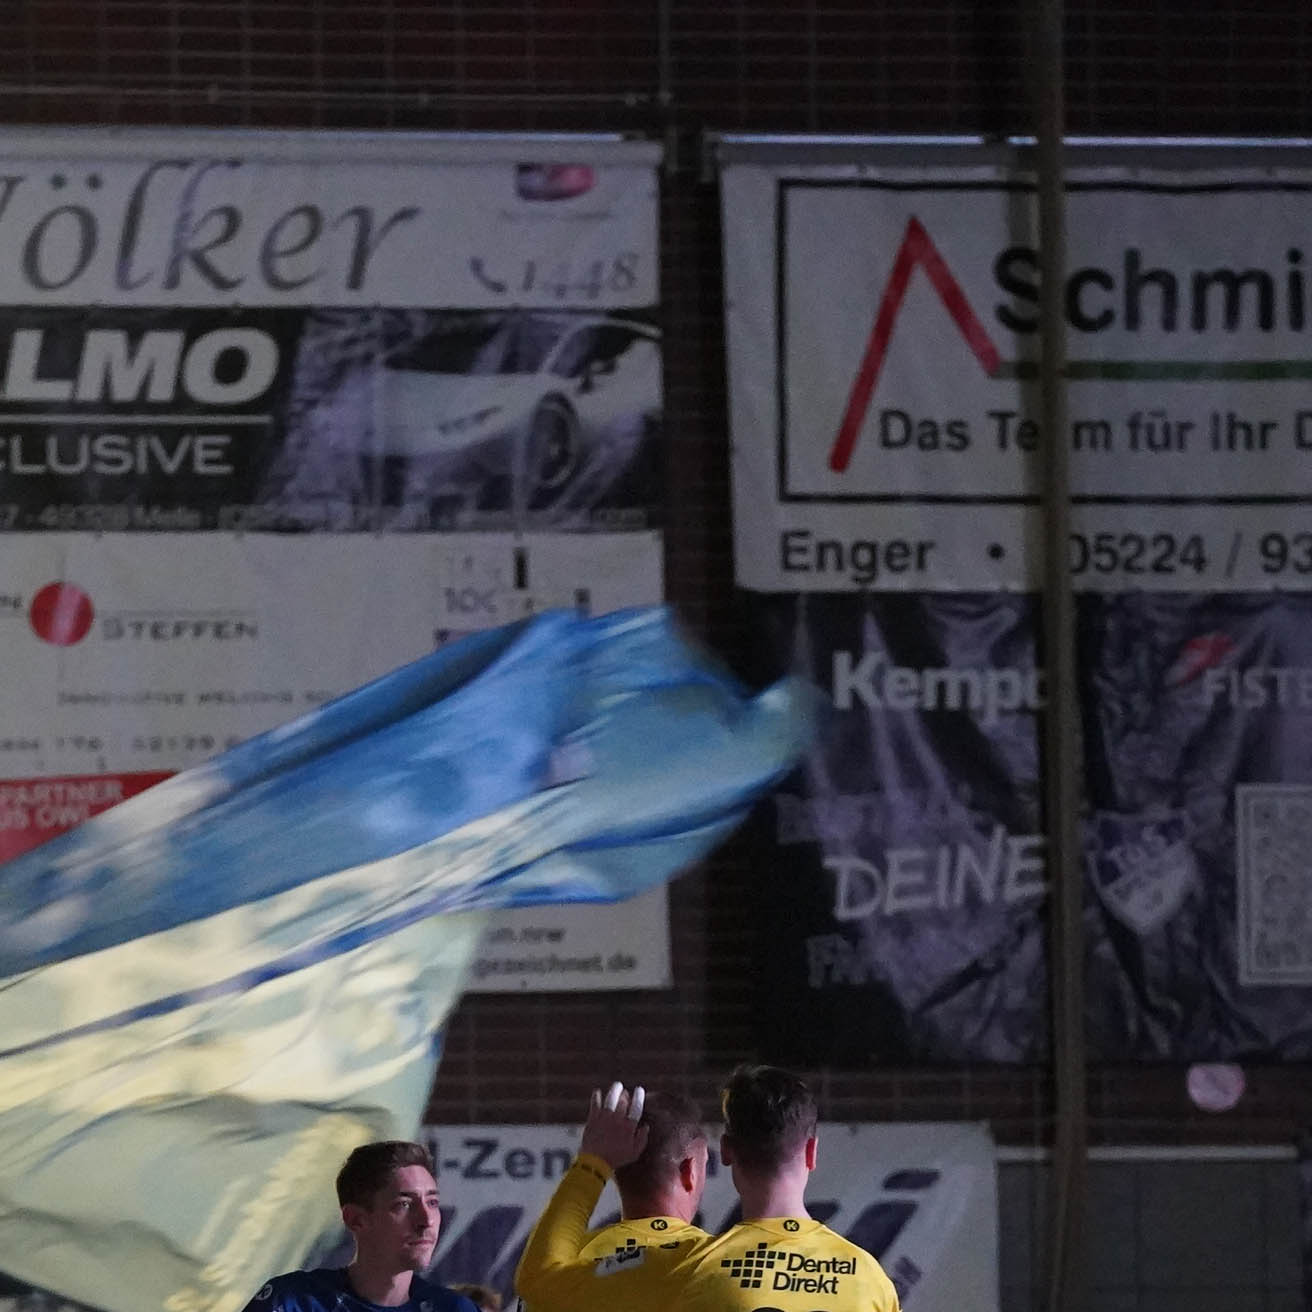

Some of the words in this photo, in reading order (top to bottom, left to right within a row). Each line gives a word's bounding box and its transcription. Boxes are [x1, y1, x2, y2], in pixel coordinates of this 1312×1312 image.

[880, 411, 971, 452] Das
[989, 410, 1112, 452] Tem
[1128, 410, 1195, 453] für
[1212, 411, 1277, 452] Ihr
[781, 531, 936, 585] Enger
[103, 619, 258, 641] STEFFEN
[823, 823, 1050, 922] DEINE
[787, 1252, 857, 1276] Dental
[773, 1271, 840, 1295] Direkt
